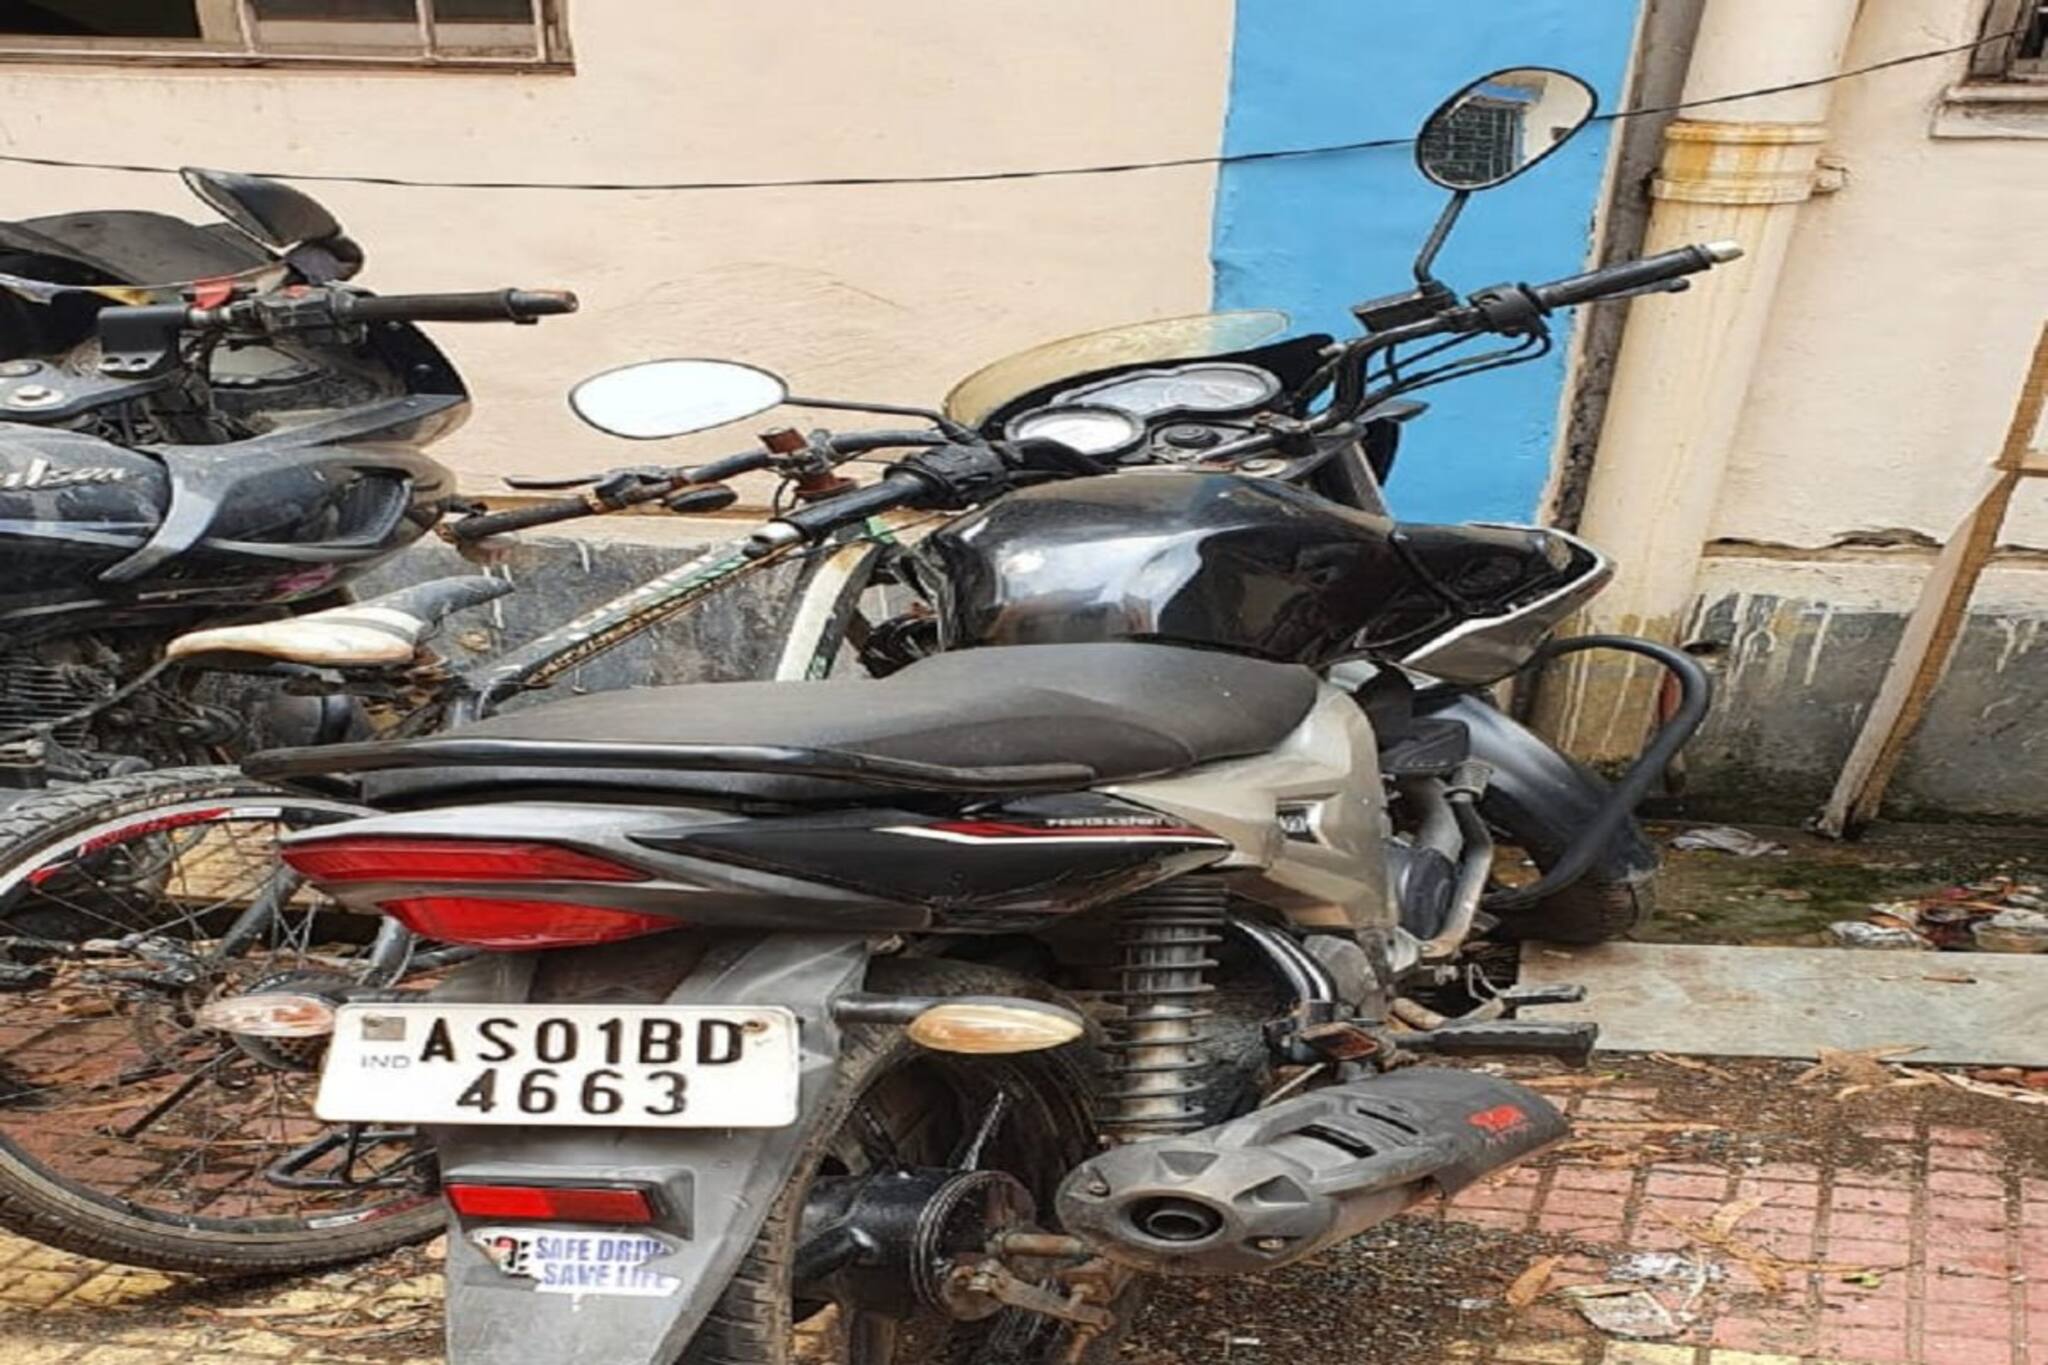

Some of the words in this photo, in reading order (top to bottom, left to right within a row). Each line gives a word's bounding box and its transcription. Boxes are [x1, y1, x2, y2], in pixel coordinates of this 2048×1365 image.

[419, 1017, 745, 1066] AS01BD
[361, 1055, 411, 1069] IND
[456, 1068, 688, 1116] 4663
[535, 1235, 592, 1261] SAFE
[543, 1263, 610, 1287] SAVE
